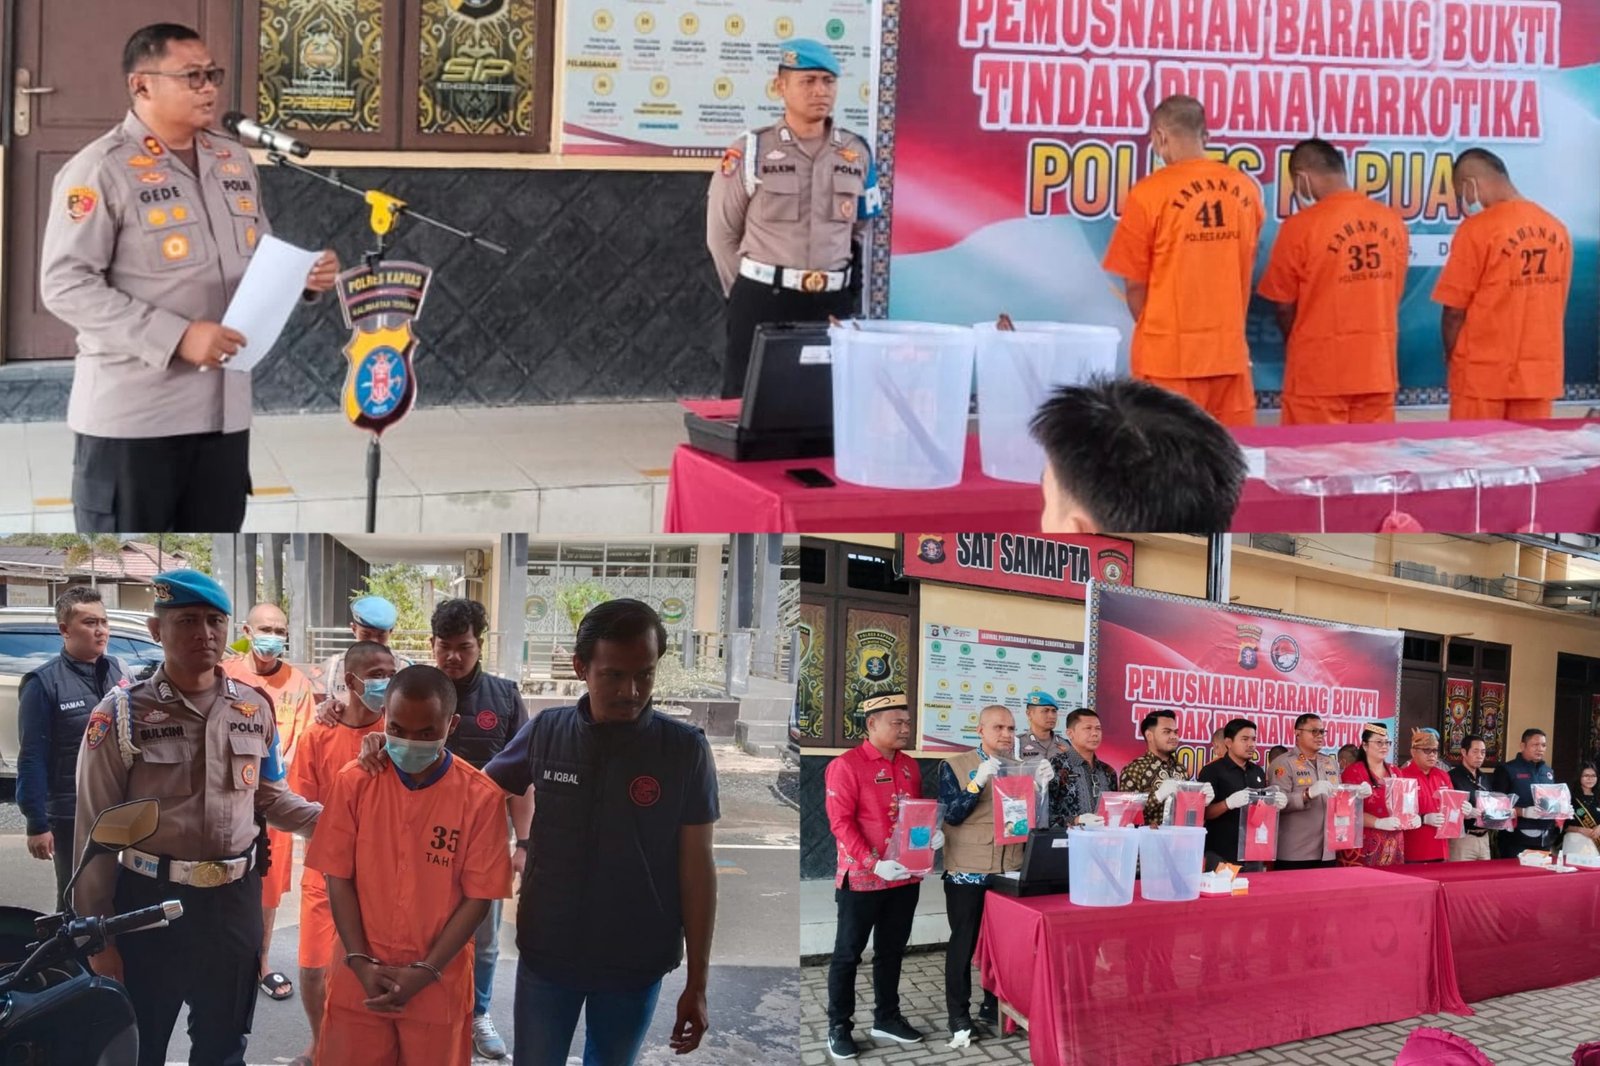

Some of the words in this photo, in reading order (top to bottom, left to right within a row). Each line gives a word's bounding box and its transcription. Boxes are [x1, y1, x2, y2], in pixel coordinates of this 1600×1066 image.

[961, 0, 1260, 56] PEMUSNAHAN
[1272, 0, 1432, 62] BARANG
[1440, 1, 1560, 67] BUKTI
[976, 56, 1148, 132] TINDAK
[1320, 68, 1544, 141] NARKOTIKA
[834, 165, 861, 176] POLRI
[140, 186, 182, 203] GEDE
[222, 180, 252, 192] POLRI
[1195, 200, 1225, 228] 41
[1348, 243, 1380, 272] 35
[1520, 249, 1547, 276] 27
[348, 273, 384, 294] POLRES
[386, 272, 422, 287] KAPUAS
[956, 532, 998, 570] SAT
[1000, 533, 1092, 584] SAMAPTA
[1125, 664, 1261, 710] PEMUSNAHAN
[1263, 679, 1329, 715] BARANG
[1332, 687, 1379, 718] BUKTI
[230, 722, 263, 735] POLRI
[553, 771, 579, 785] IQBAL
[430, 825, 460, 853] 35
